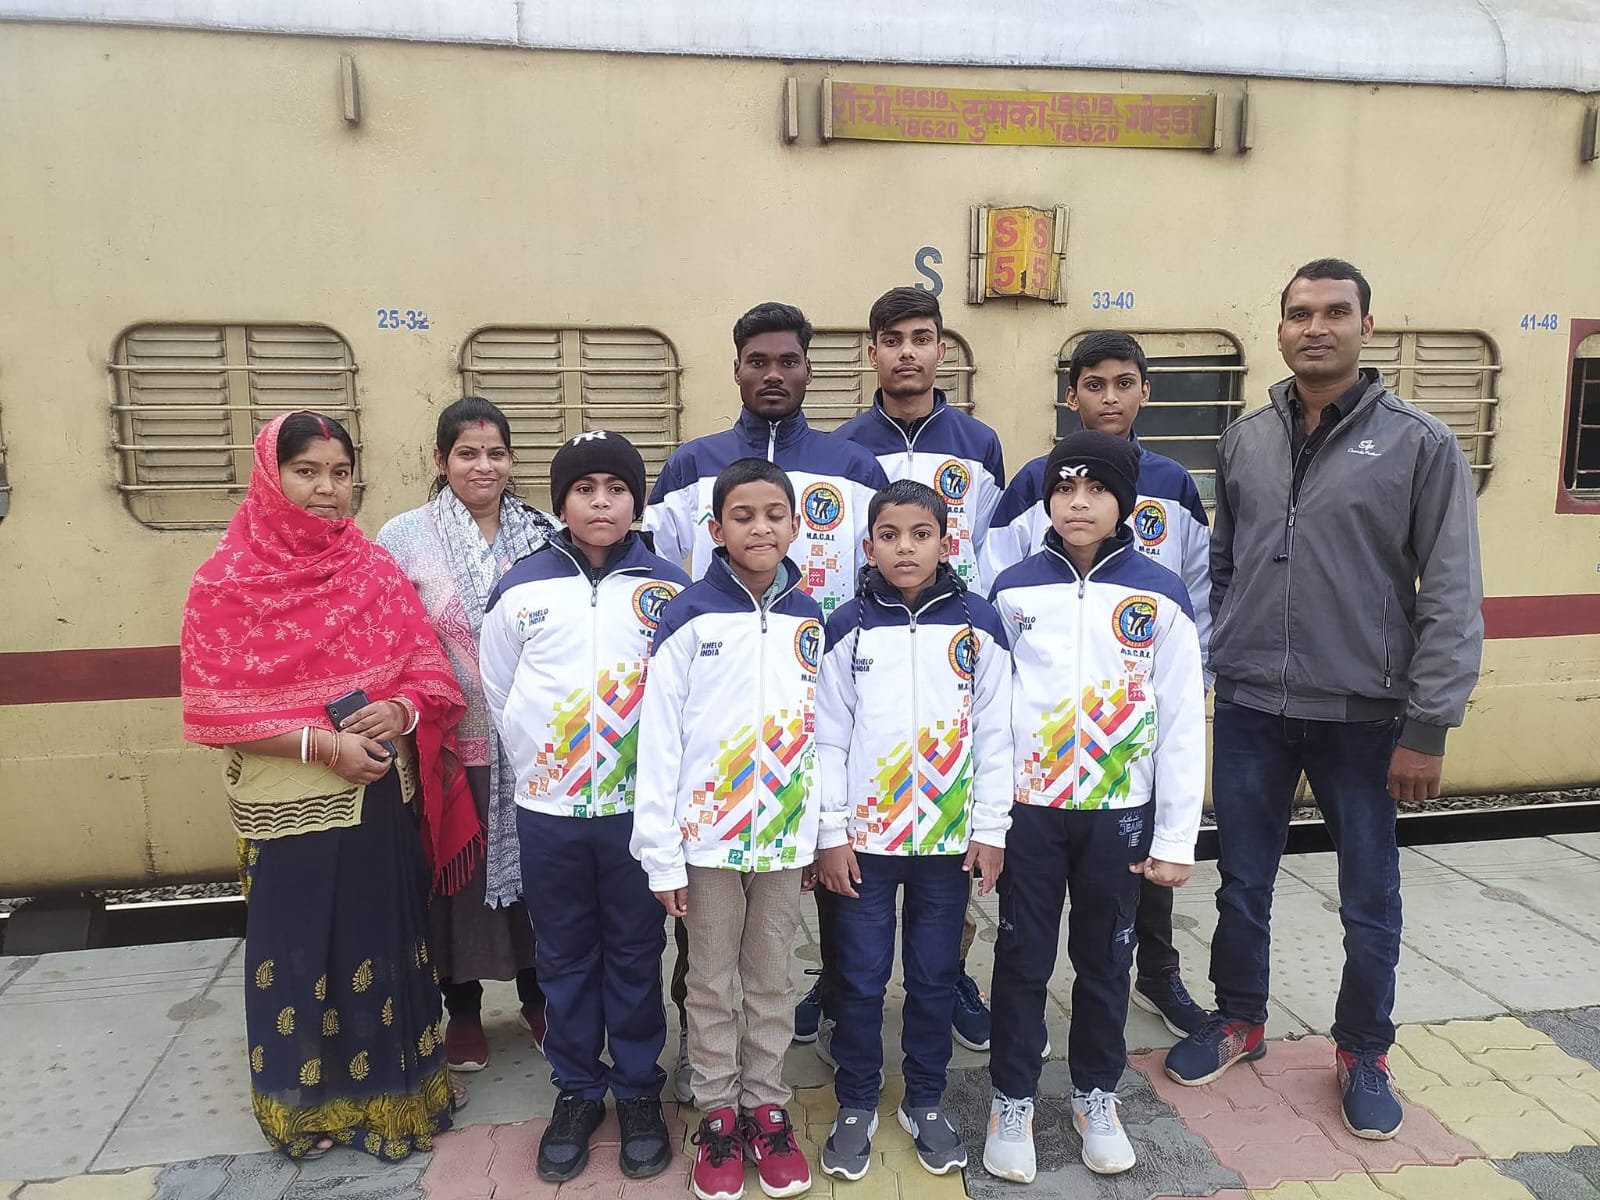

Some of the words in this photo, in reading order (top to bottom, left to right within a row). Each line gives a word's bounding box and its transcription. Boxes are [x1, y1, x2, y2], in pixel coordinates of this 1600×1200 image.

[901, 118, 959, 139] 18620
[994, 216, 1018, 248] S
[1033, 218, 1048, 249] S
[914, 246, 944, 297] S
[994, 256, 1015, 287] 5
[1032, 258, 1046, 289] 5
[1092, 291, 1134, 310] 33-40
[377, 309, 430, 330] 25-32
[1520, 313, 1558, 331] 41-48
[700, 649, 720, 657] INDIA
[701, 641, 723, 650] KHELO
